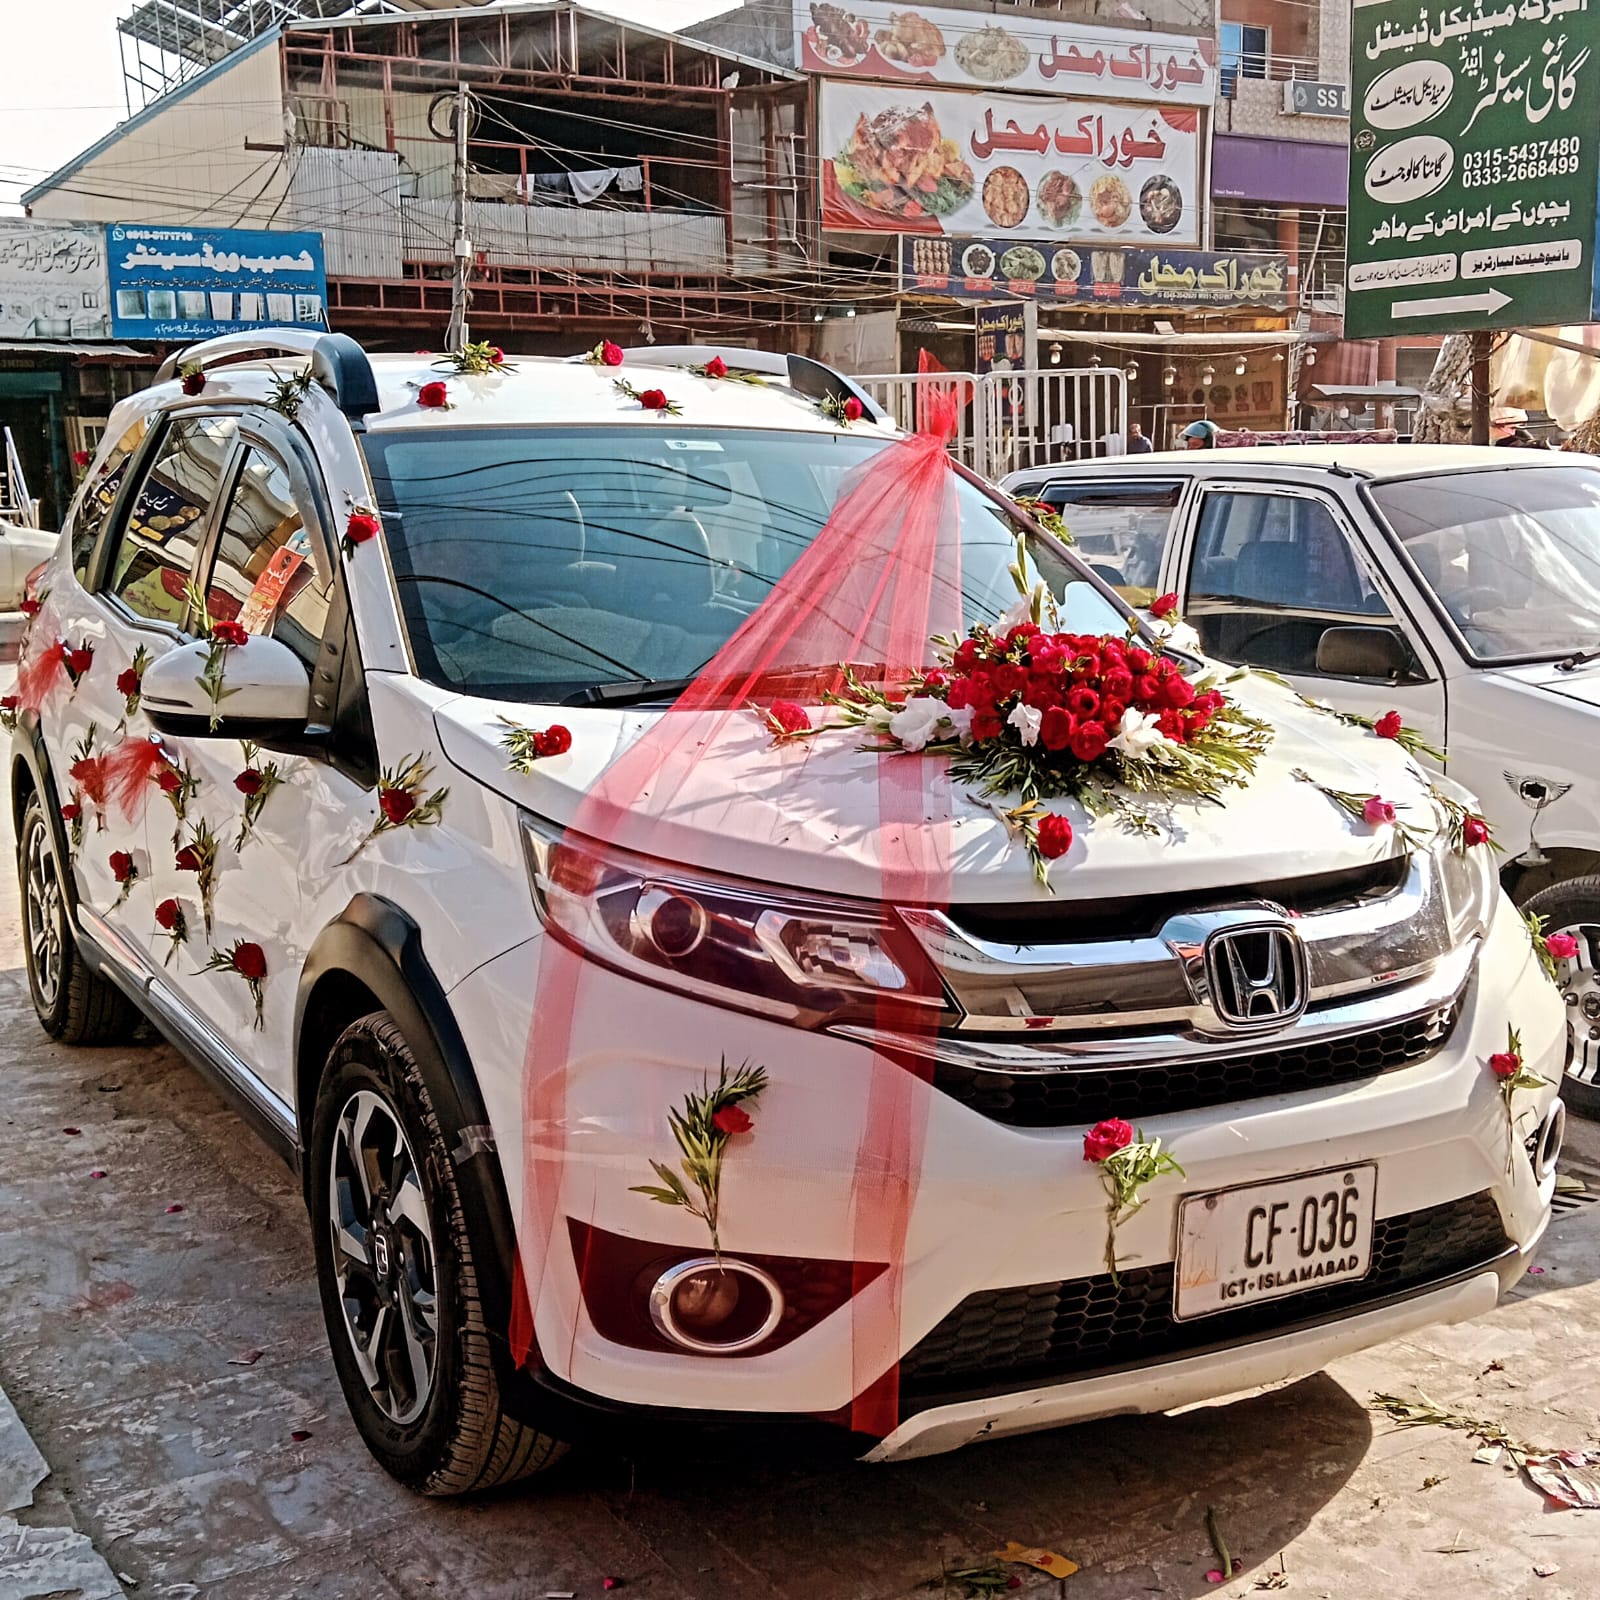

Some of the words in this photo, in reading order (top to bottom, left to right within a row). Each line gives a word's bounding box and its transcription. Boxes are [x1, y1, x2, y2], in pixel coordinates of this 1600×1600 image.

[1365, 7, 1429, 60] ڈینٹل
[1430, 0, 1517, 47] میڈیکل
[1038, 35, 1107, 80] محل
[1108, 42, 1208, 91] خوراک
[1458, 46, 1483, 77] اینڈ
[1459, 50, 1532, 137] سینٹر
[1525, 33, 1592, 123] گائنی
[1317, 88, 1338, 109] SS
[971, 106, 1052, 160] محل
[1055, 114, 1168, 169] خوراک
[1463, 136, 1580, 170] 0315-5437480
[1463, 156, 1579, 188] 0333-2668499
[1367, 214, 1407, 245] ماہر
[1406, 211, 1435, 242] کے
[1434, 204, 1491, 237] امراض
[1490, 200, 1523, 231] کے
[1522, 198, 1571, 227] بچوں
[119, 242, 201, 271] سینٹر
[201, 242, 241, 273] ووڈ
[240, 249, 315, 273] شعیب
[1138, 255, 1197, 297] محل
[1197, 257, 1283, 299] خوراک
[1244, 1186, 1360, 1269] CF-036
